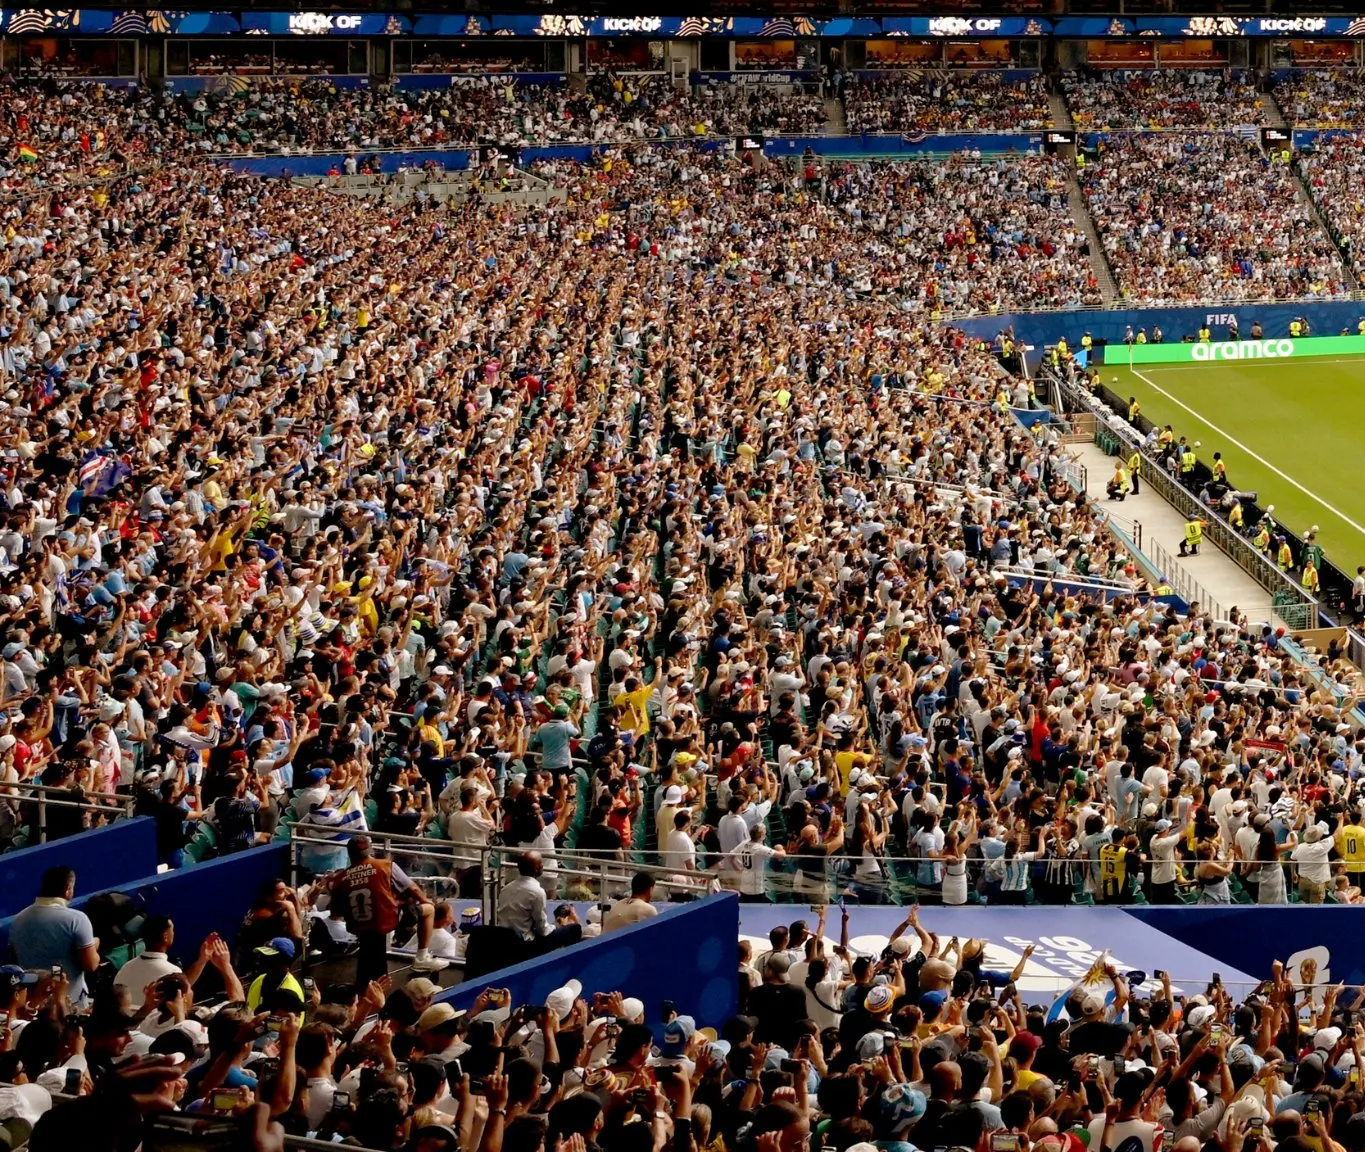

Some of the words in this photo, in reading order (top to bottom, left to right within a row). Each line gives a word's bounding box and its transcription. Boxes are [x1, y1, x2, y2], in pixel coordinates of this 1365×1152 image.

[289, 15, 334, 29] KICK
[336, 15, 362, 29] OF
[604, 19, 639, 30] KICK
[929, 19, 973, 31] KICK
[975, 19, 1001, 31] OF
[1260, 19, 1302, 30] KICK
[1206, 313, 1237, 326] FIFA
[1191, 339, 1294, 361] aramco
[1347, 838, 1357, 854] 10
[346, 863, 373, 875] MEDIA
